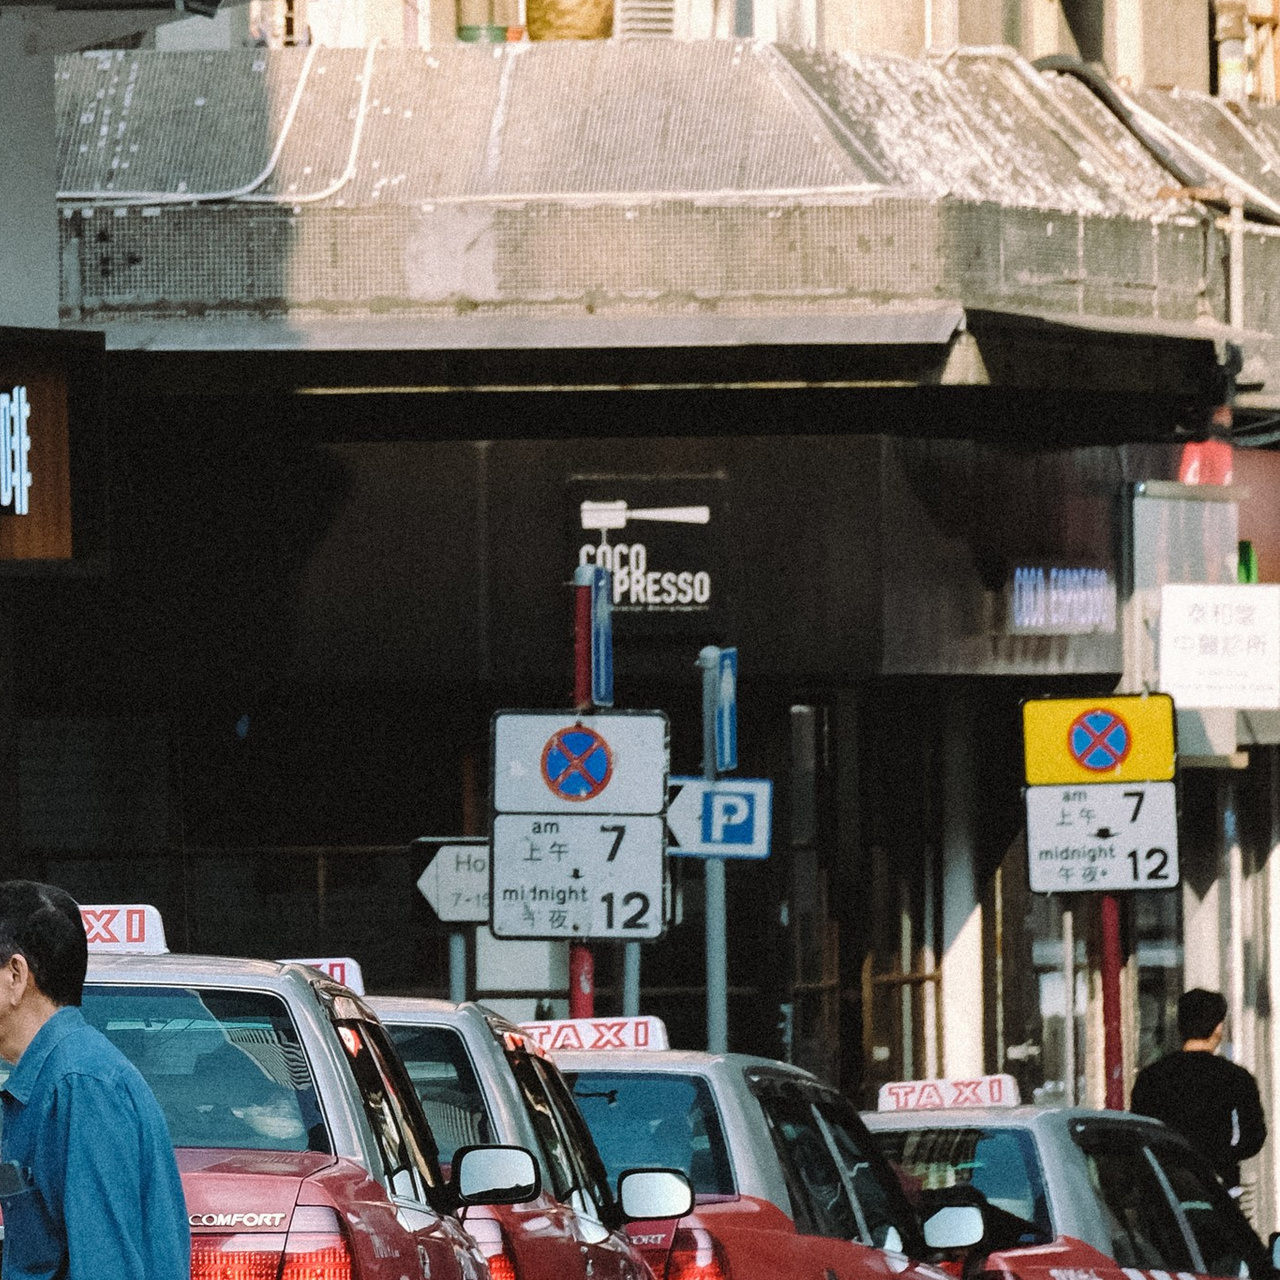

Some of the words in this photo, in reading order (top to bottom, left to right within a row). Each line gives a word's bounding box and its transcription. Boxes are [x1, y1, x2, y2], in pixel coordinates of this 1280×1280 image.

[579, 543, 647, 576] COCO
[613, 571, 712, 604] PRESSO
[1061, 790, 1087, 802] am
[1124, 792, 1145, 823] 7
[532, 822, 559, 834] am
[711, 795, 749, 842] P
[523, 840, 569, 862] 上午
[600, 825, 626, 862] 7
[1038, 846, 1116, 861] midnight
[455, 854, 486, 873] Ho
[1128, 848, 1169, 880] 12
[601, 891, 651, 929] 12
[82, 909, 145, 943] XI
[520, 1021, 649, 1049] TAXI
[888, 1079, 1002, 1110] TAXI
[189, 1213, 286, 1227] COMFORT
